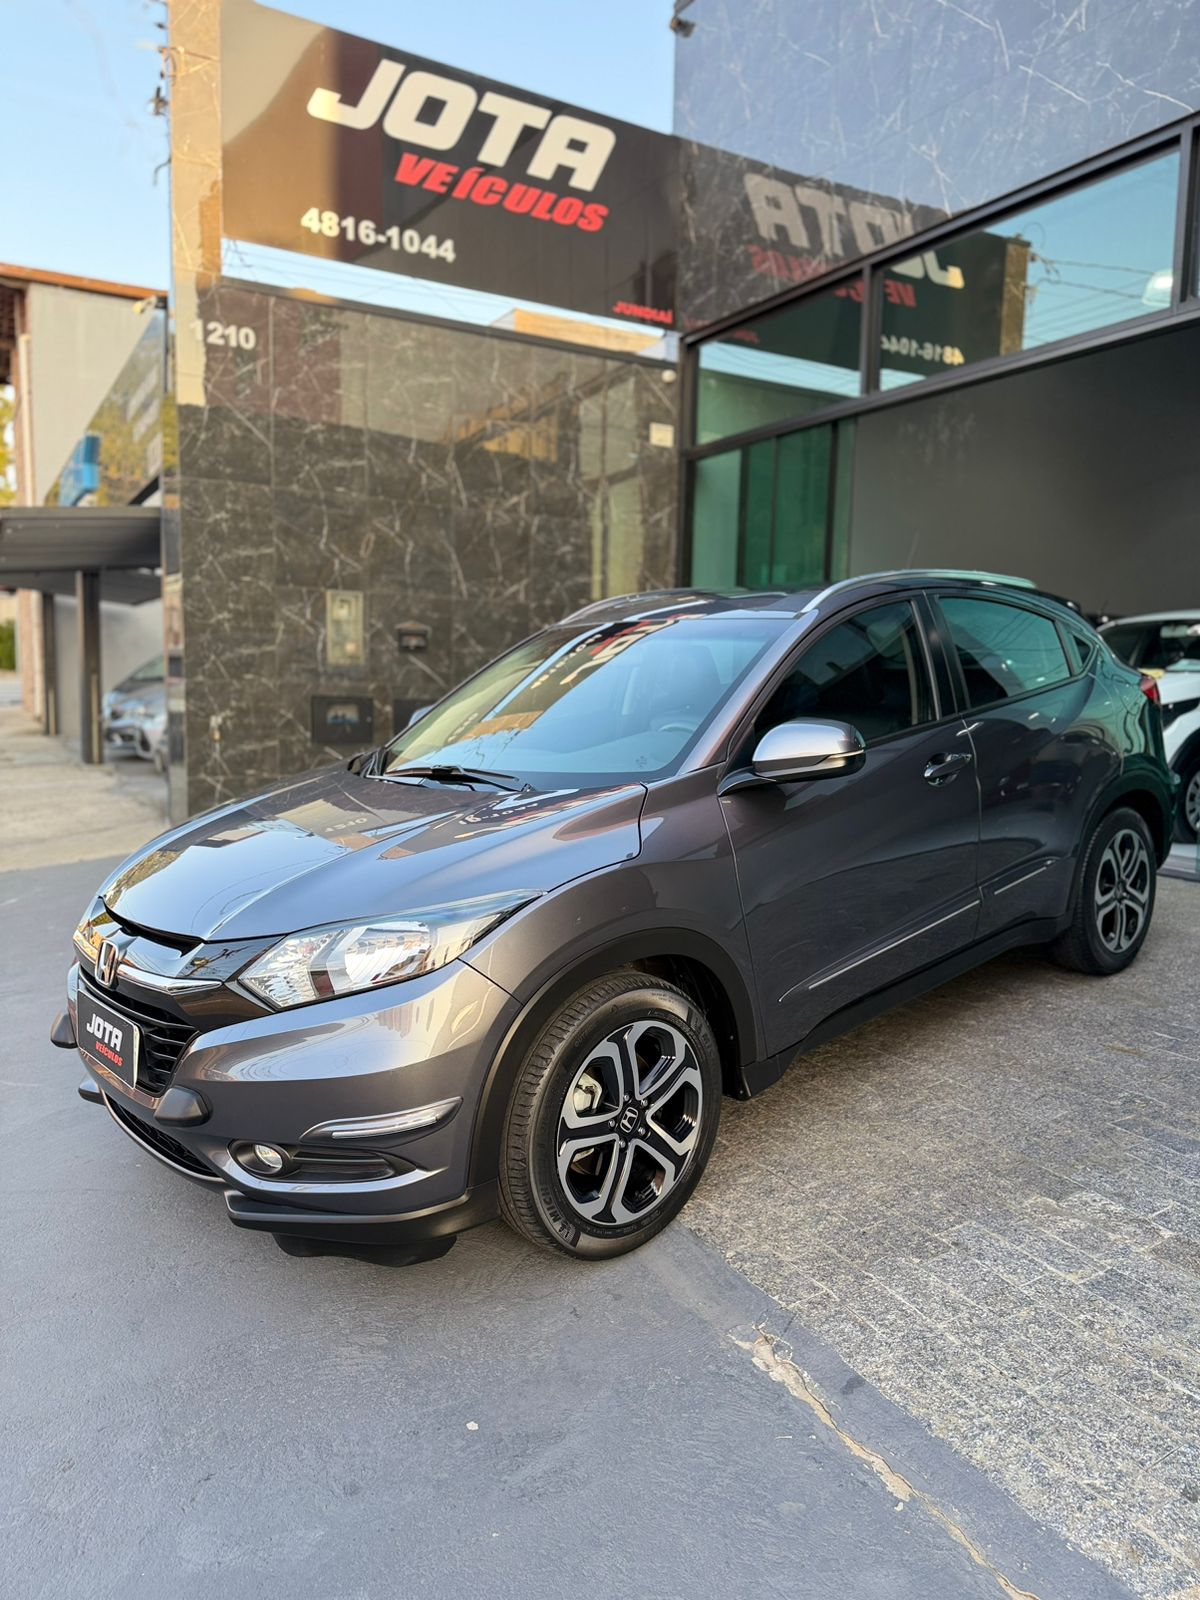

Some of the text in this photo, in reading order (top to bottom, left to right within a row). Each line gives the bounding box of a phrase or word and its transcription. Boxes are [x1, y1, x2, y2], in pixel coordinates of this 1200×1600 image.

[307, 58, 617, 192] JOTA
[395, 152, 609, 232] VEÍCULOS
[301, 207, 456, 263] 4816-1044
[189, 319, 257, 350] 1210
[86, 1013, 123, 1052] JOTA
